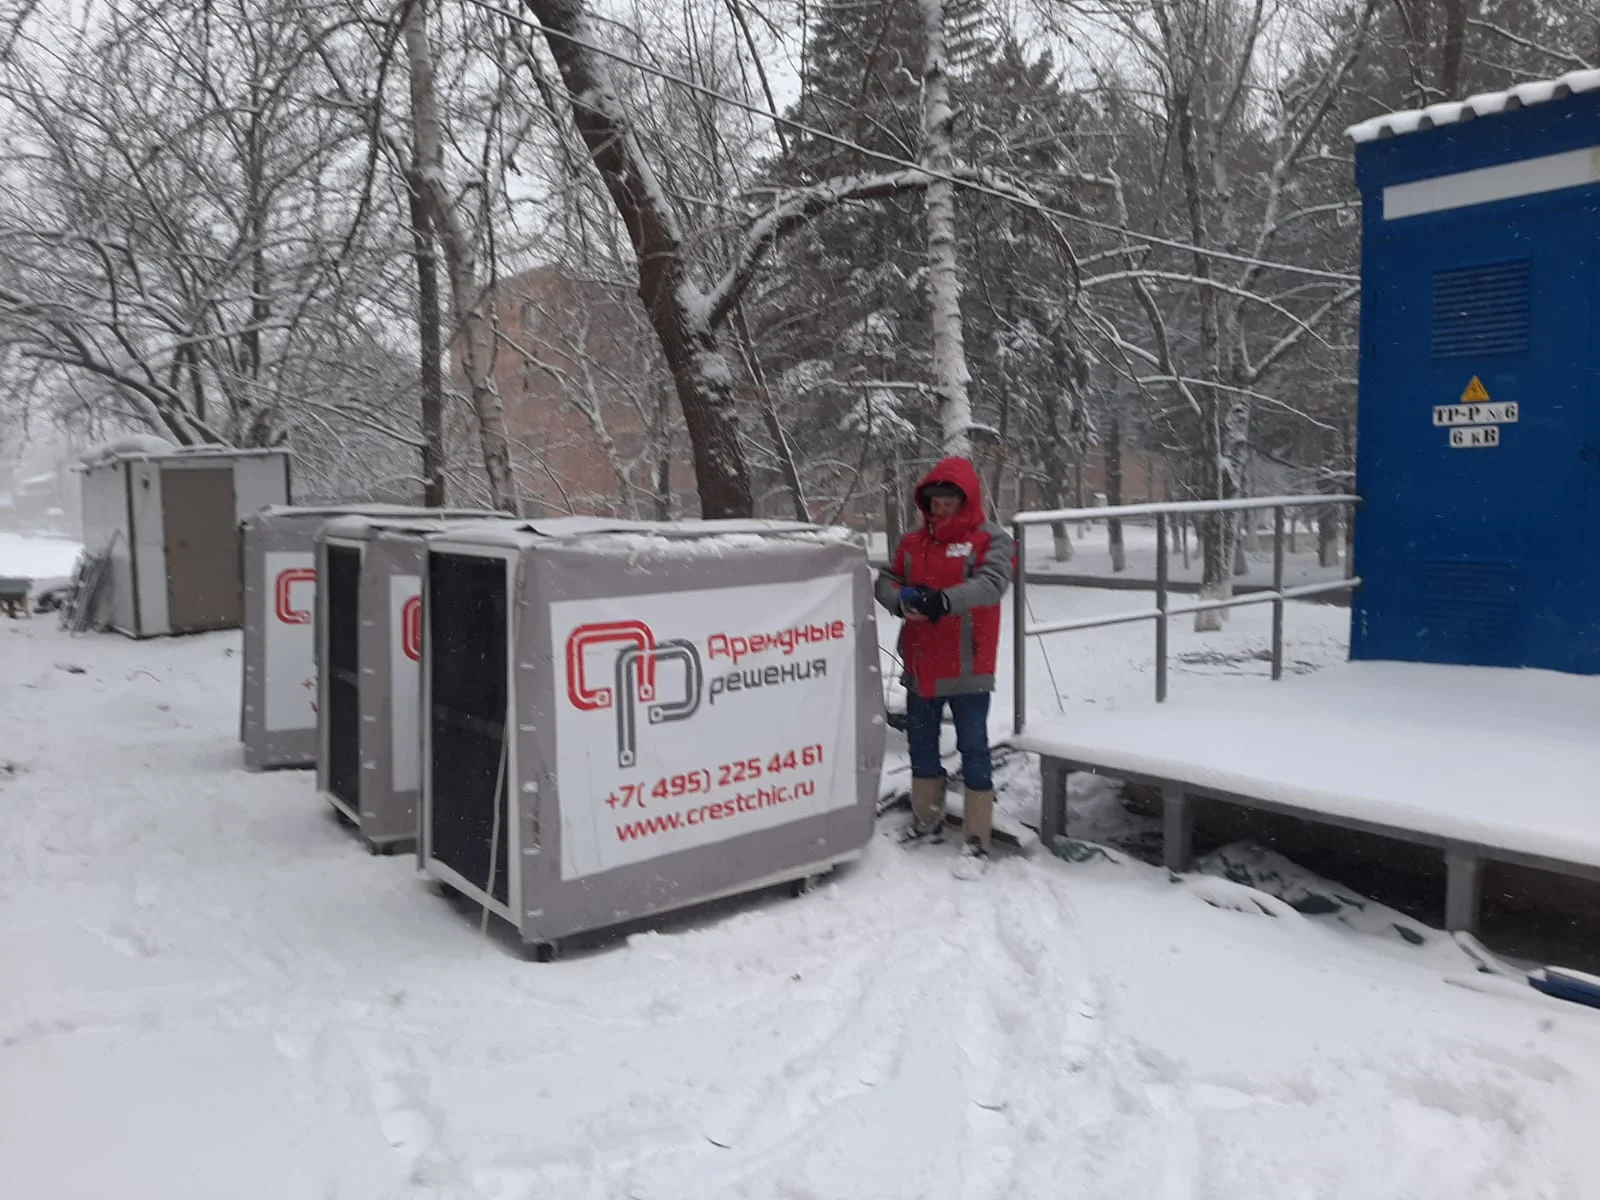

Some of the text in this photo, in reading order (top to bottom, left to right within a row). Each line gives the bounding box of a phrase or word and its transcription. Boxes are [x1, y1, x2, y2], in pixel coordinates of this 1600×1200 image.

[1453, 430, 1463, 445] 6
[707, 619, 845, 665] Арендные
[709, 658, 827, 705] решения
[717, 758, 762, 787] 225
[766, 752, 797, 773] 44
[801, 743, 824, 766] 61
[615, 779, 815, 842] www.crestchic.ru
